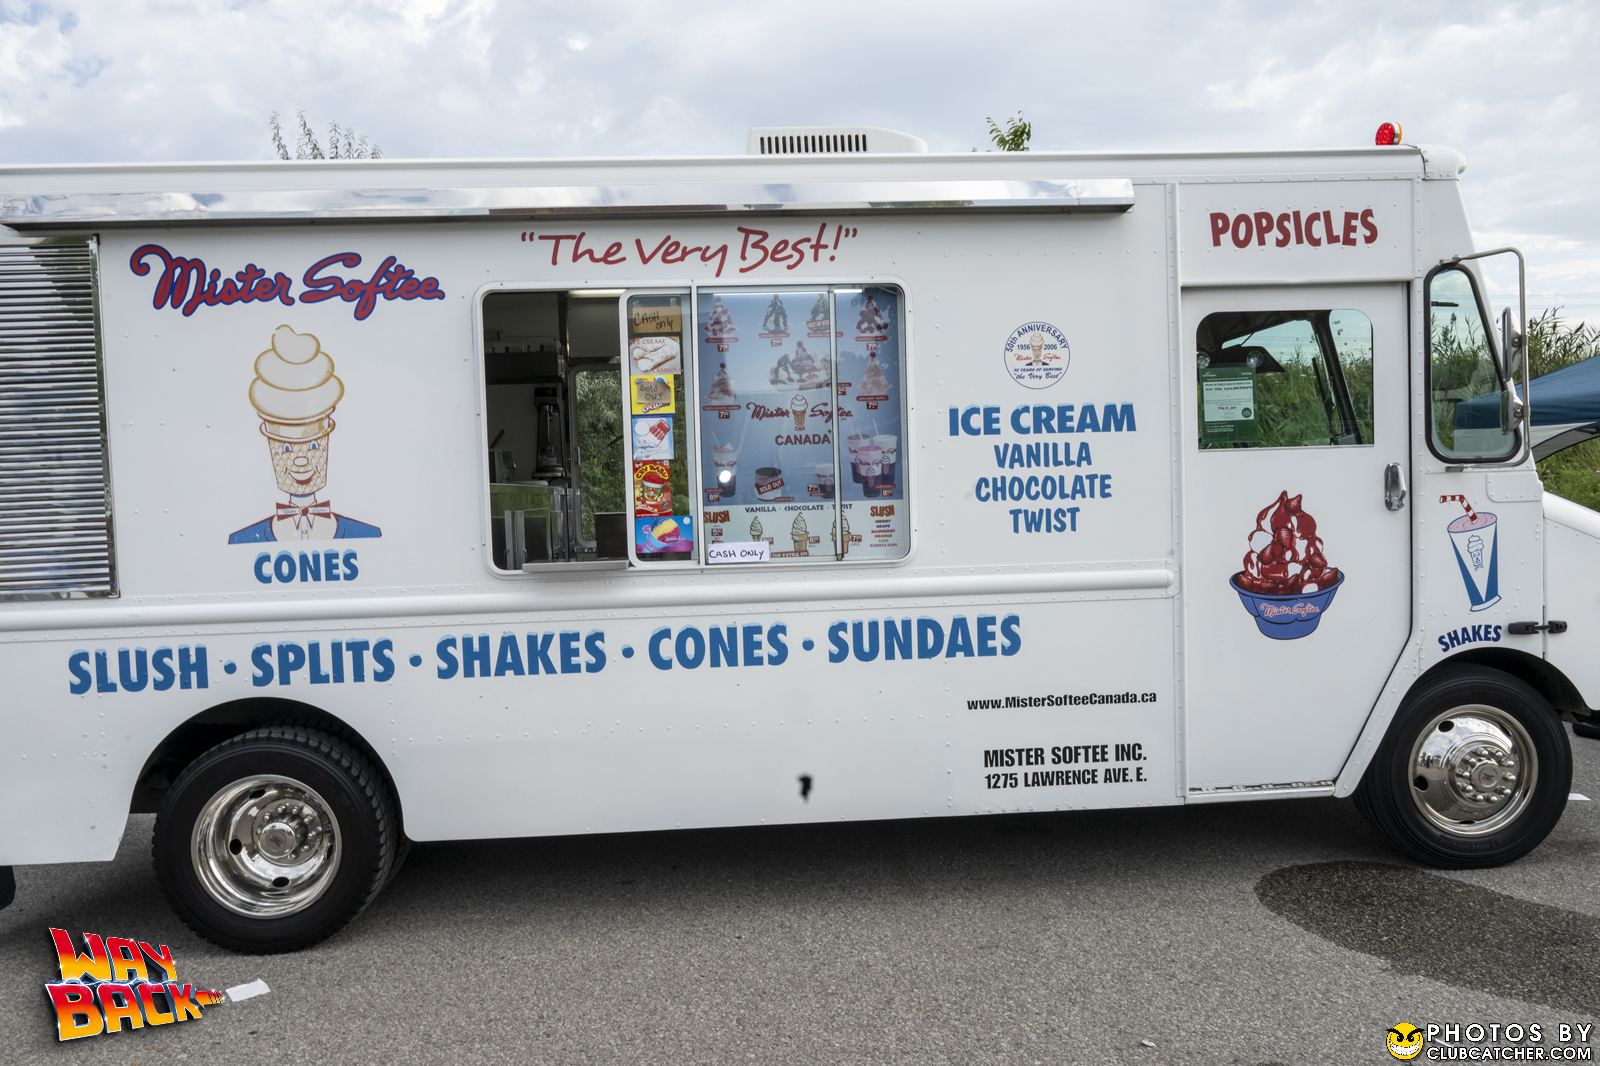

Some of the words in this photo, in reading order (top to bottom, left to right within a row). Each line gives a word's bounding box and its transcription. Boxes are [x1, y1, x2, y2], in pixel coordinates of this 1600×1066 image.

[1209, 209, 1378, 249] POPSICLES
[635, 235, 728, 278] Very
[130, 244, 296, 317] Mister
[299, 252, 445, 321] Softee
[655, 317, 674, 331] only
[1005, 336, 1018, 352] 50th
[1017, 324, 1068, 349] ANNIVERSARY
[1017, 343, 1031, 351] 1956
[1043, 343, 1058, 351] 2006
[746, 402, 790, 421] Mister
[948, 404, 1001, 437] ICE
[1010, 401, 1137, 435] CREAM
[775, 434, 831, 446] CANADA
[993, 441, 1092, 469] VANILLA
[975, 473, 1112, 502] CHOCOLATE
[704, 510, 730, 524] SLUSH
[870, 504, 895, 517] SLUSH
[1008, 507, 1080, 534] TWIST
[254, 549, 359, 584] CONES
[708, 550, 737, 559] CASH
[740, 549, 764, 560] ONLY
[1438, 624, 1502, 652] SHAKES
[67, 644, 209, 695] SLUSH
[250, 637, 396, 687] SPLITS
[436, 628, 607, 681] SHAKES
[648, 622, 789, 671] CONES
[827, 613, 1021, 664] SUNDAES
[967, 691, 1157, 710] www.MisterSofteeCanada.ca
[984, 747, 1045, 768] MISTER
[1051, 744, 1109, 765] SOFTEE
[1115, 742, 1147, 762] INC.
[984, 773, 1019, 789] 1275
[1024, 769, 1099, 788] LAWRENCE
[1104, 767, 1133, 784] AVE.
[1136, 766, 1147, 782] E.
